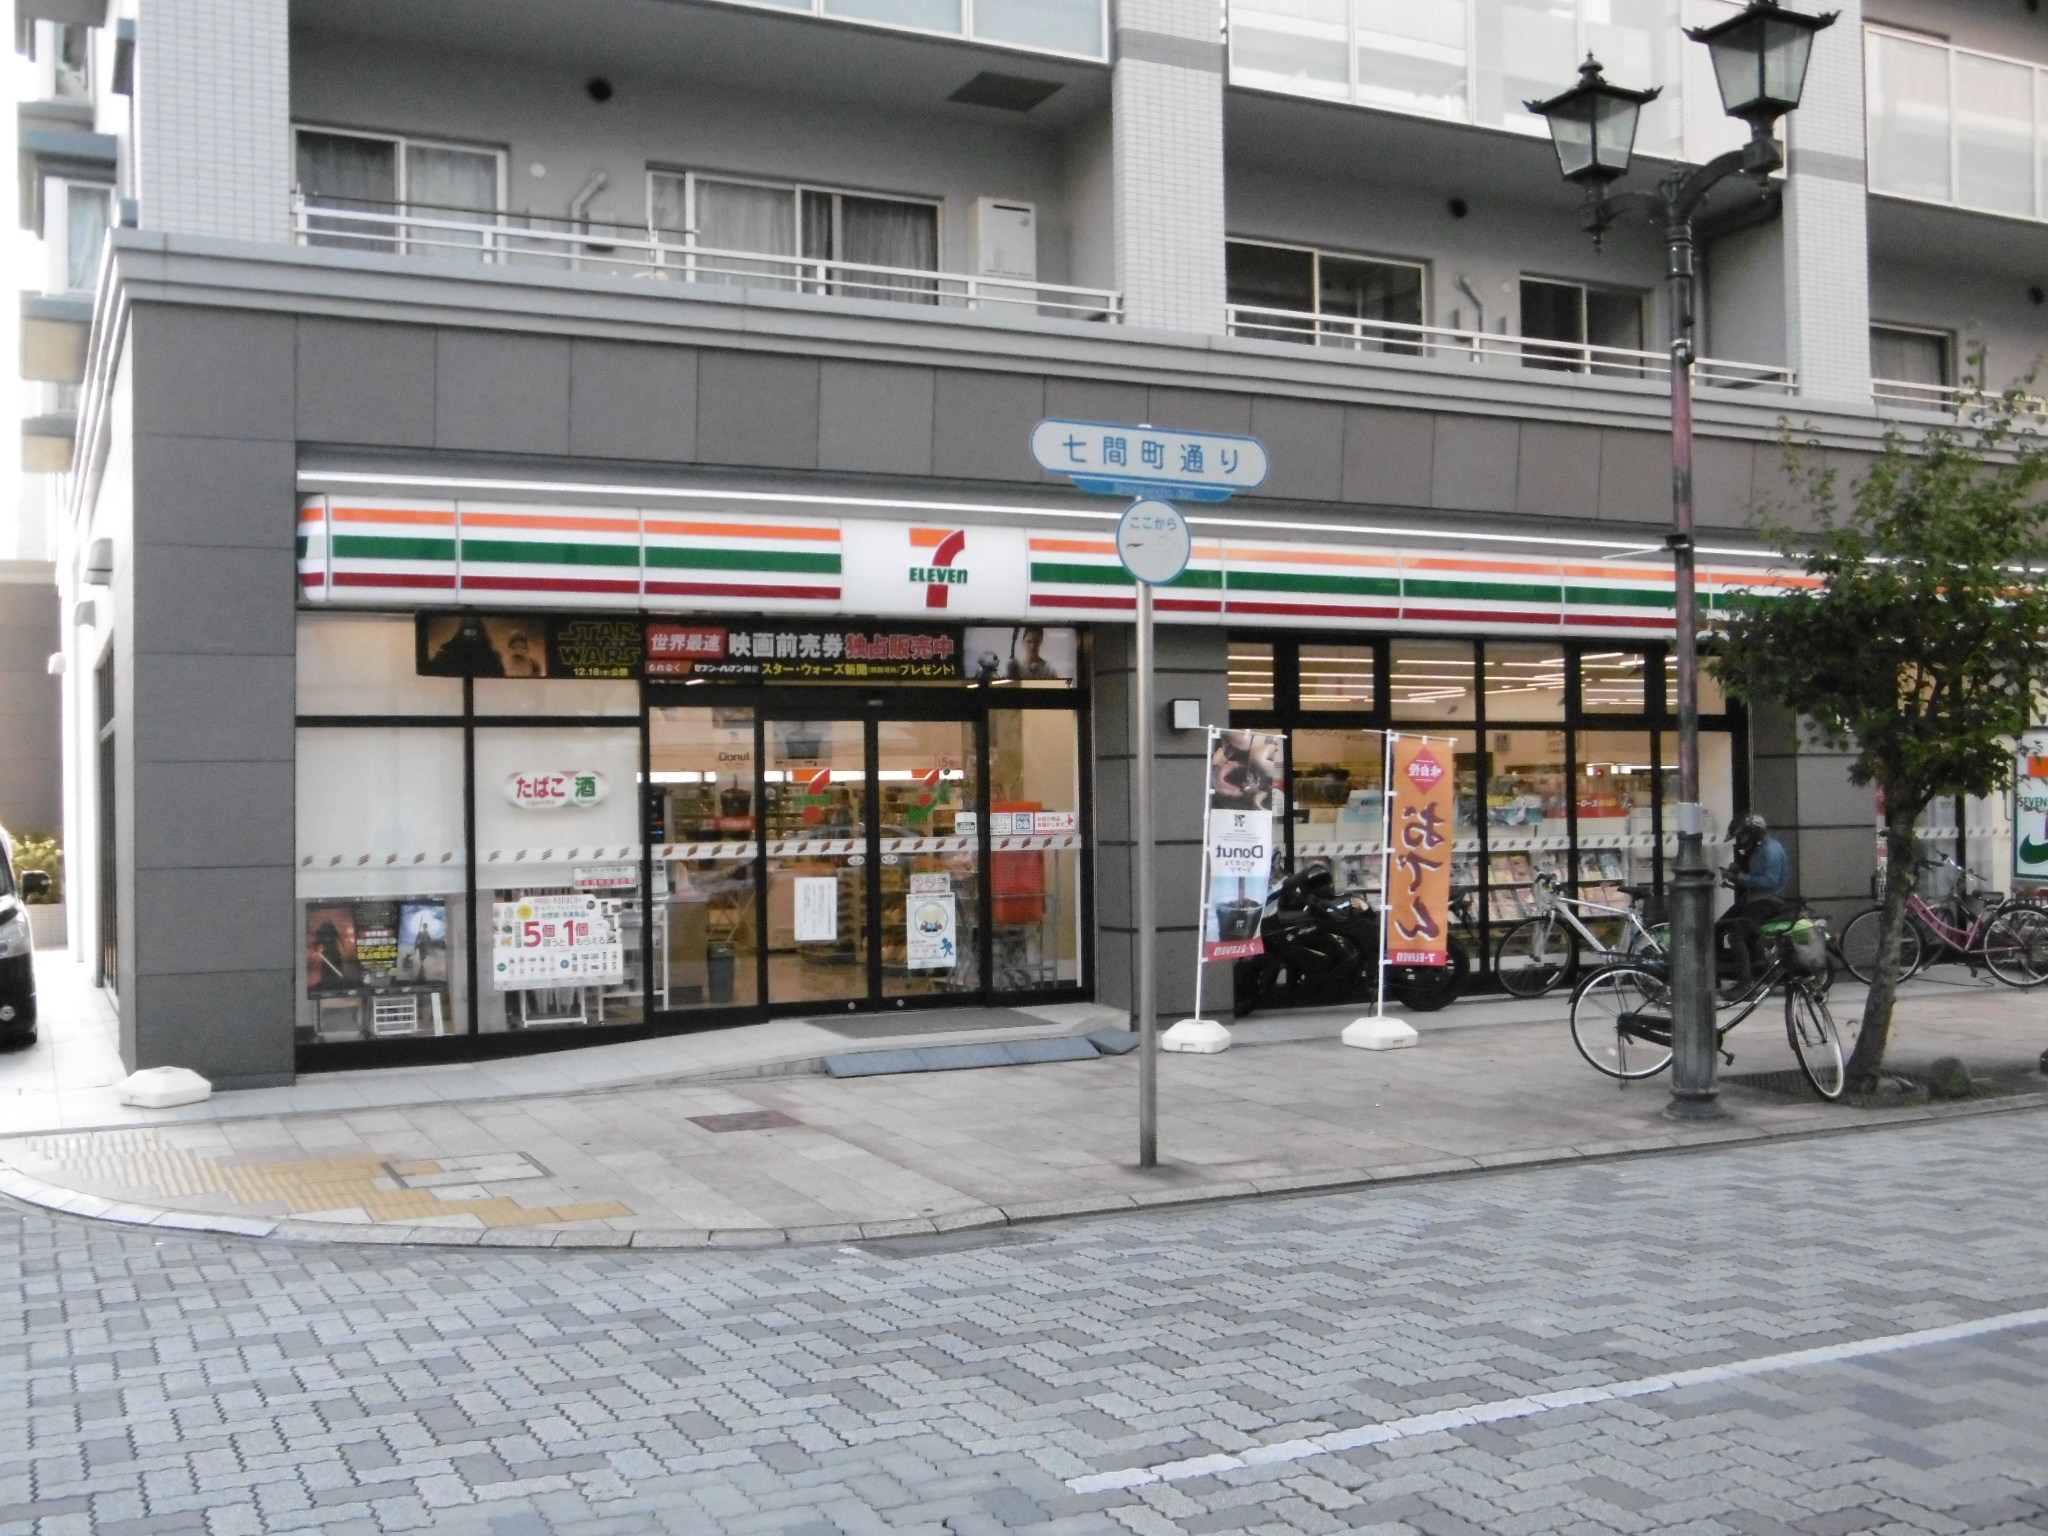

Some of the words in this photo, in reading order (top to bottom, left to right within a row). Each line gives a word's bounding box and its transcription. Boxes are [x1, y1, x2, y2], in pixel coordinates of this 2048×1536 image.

[1063, 434, 1238, 474] 七間町通り
[1130, 517, 1177, 531] ここから
[909, 567, 968, 583] ELEVEN
[558, 621, 641, 641] STAR
[651, 633, 721, 652] 世界最速
[729, 631, 843, 658] 映画前売券
[844, 633, 955, 660] 独占販売中
[558, 646, 641, 666] WARS
[718, 751, 751, 761] Donut
[516, 776, 565, 798] たばこ
[575, 776, 596, 797] 酒
